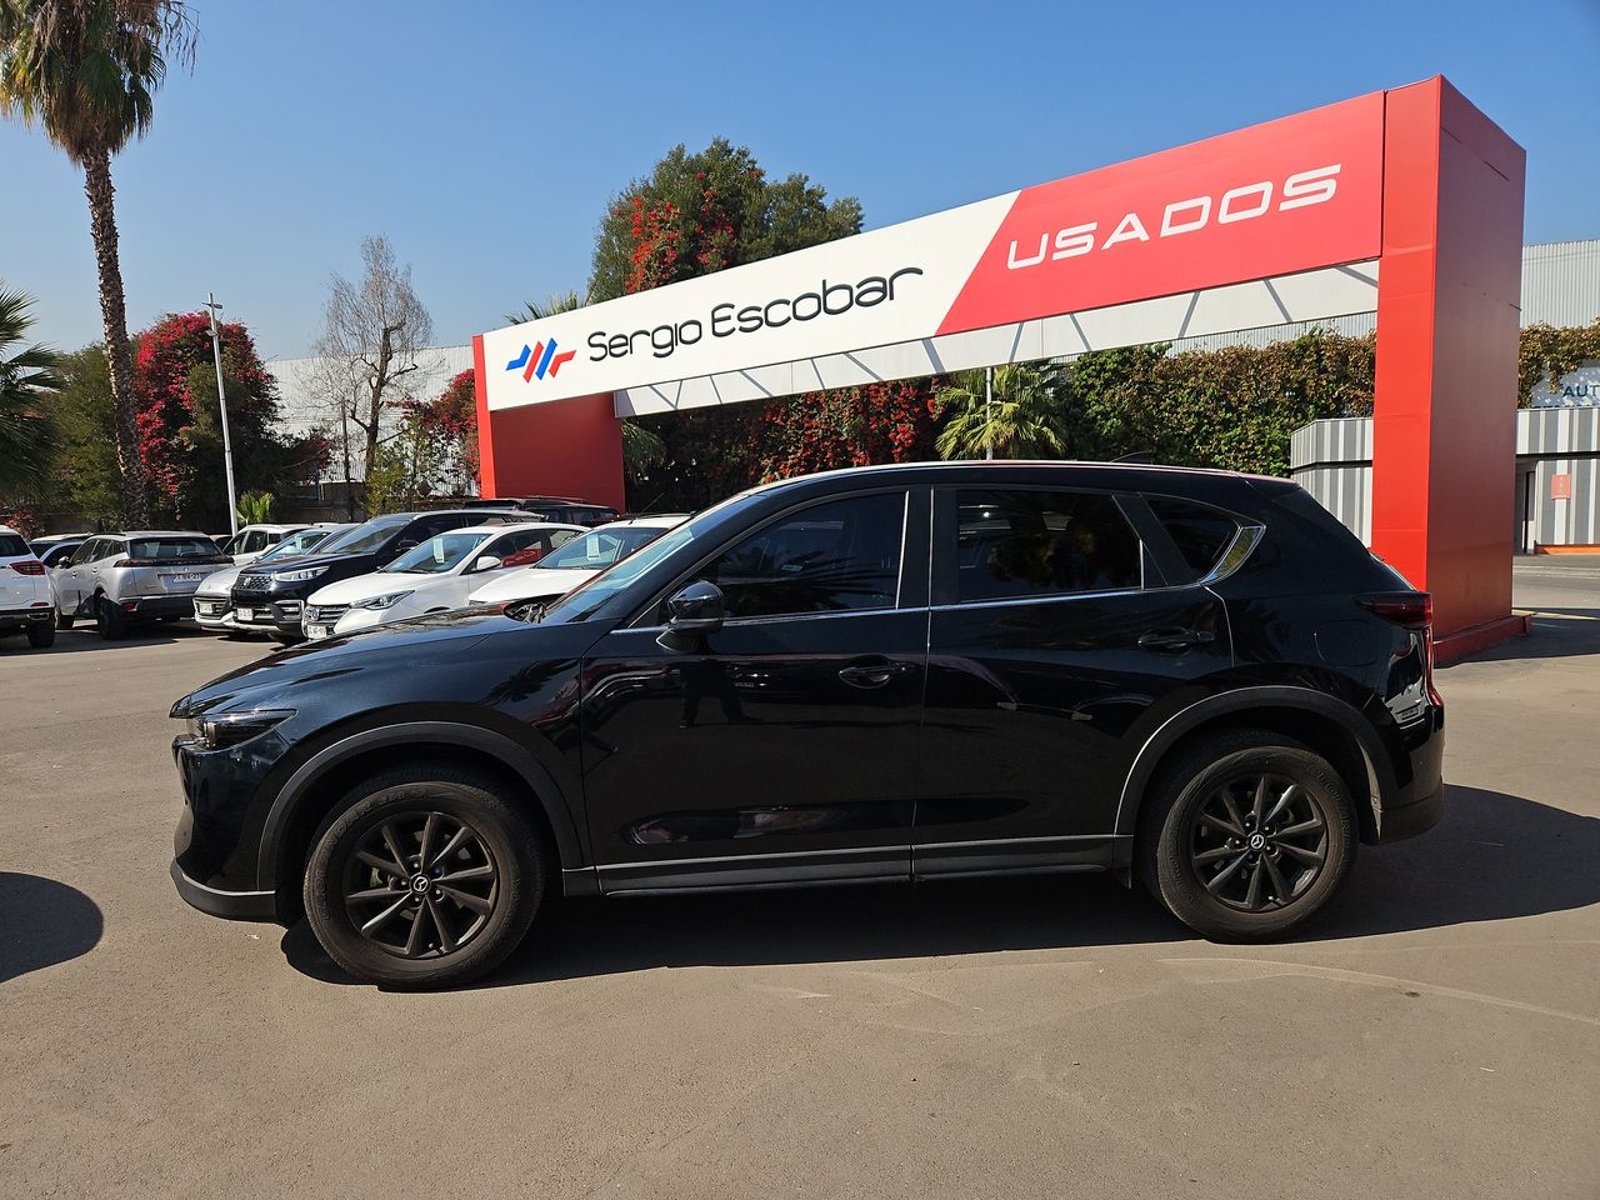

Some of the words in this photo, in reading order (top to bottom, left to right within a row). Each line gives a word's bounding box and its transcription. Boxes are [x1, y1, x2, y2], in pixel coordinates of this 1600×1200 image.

[1007, 163, 1342, 270] USADOS
[587, 318, 703, 363] Sergio
[710, 266, 924, 338] Escobar
